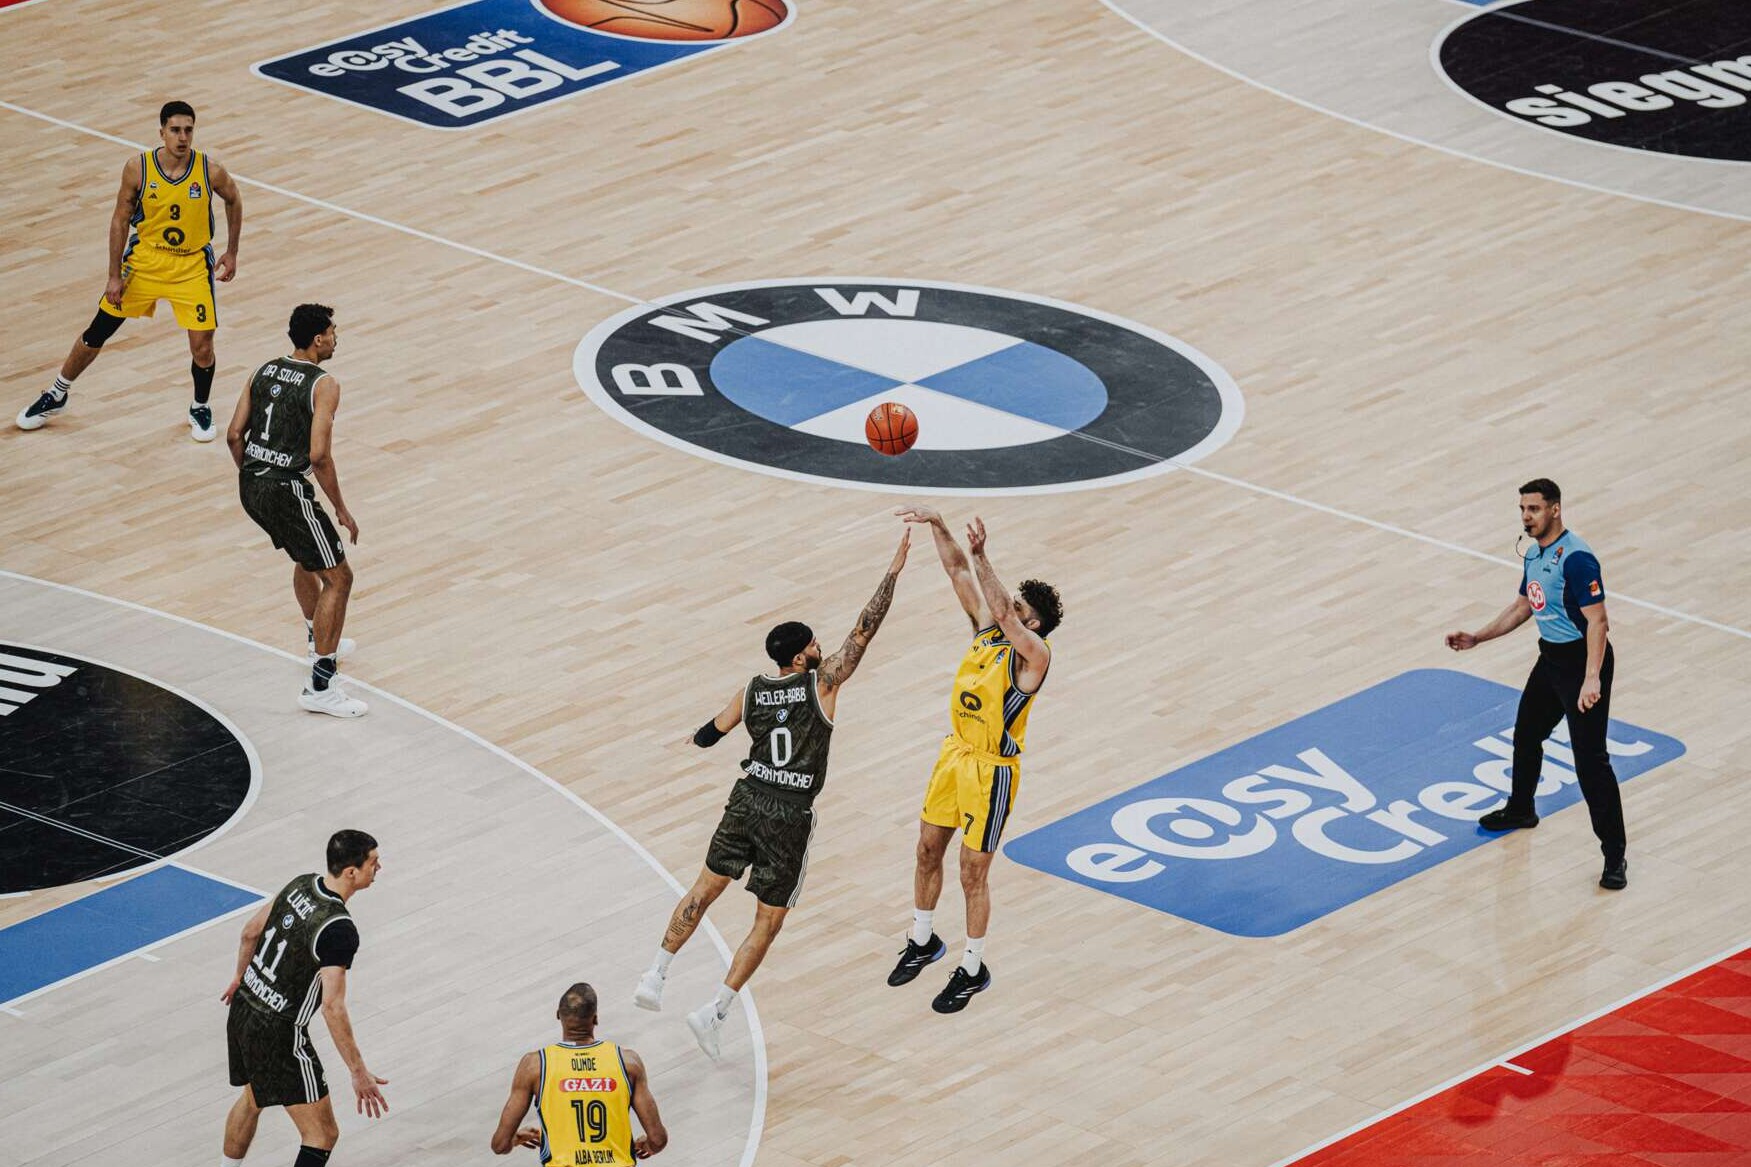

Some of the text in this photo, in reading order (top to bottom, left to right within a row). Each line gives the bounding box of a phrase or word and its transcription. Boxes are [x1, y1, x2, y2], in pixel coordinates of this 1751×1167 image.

[395, 28, 541, 74] Credit
[396, 50, 622, 118] BBL
[169, 203, 181, 221] 3
[196, 303, 206, 323] 3
[262, 364, 306, 386] DA SILVA
[260, 402, 274, 441] 1
[754, 686, 807, 707] WEILER-BABB
[770, 726, 792, 767] 0
[963, 813, 975, 836] 7
[252, 925, 287, 983] 11
[570, 1099, 607, 1142] 19
[575, 1149, 593, 1166] ALBA
